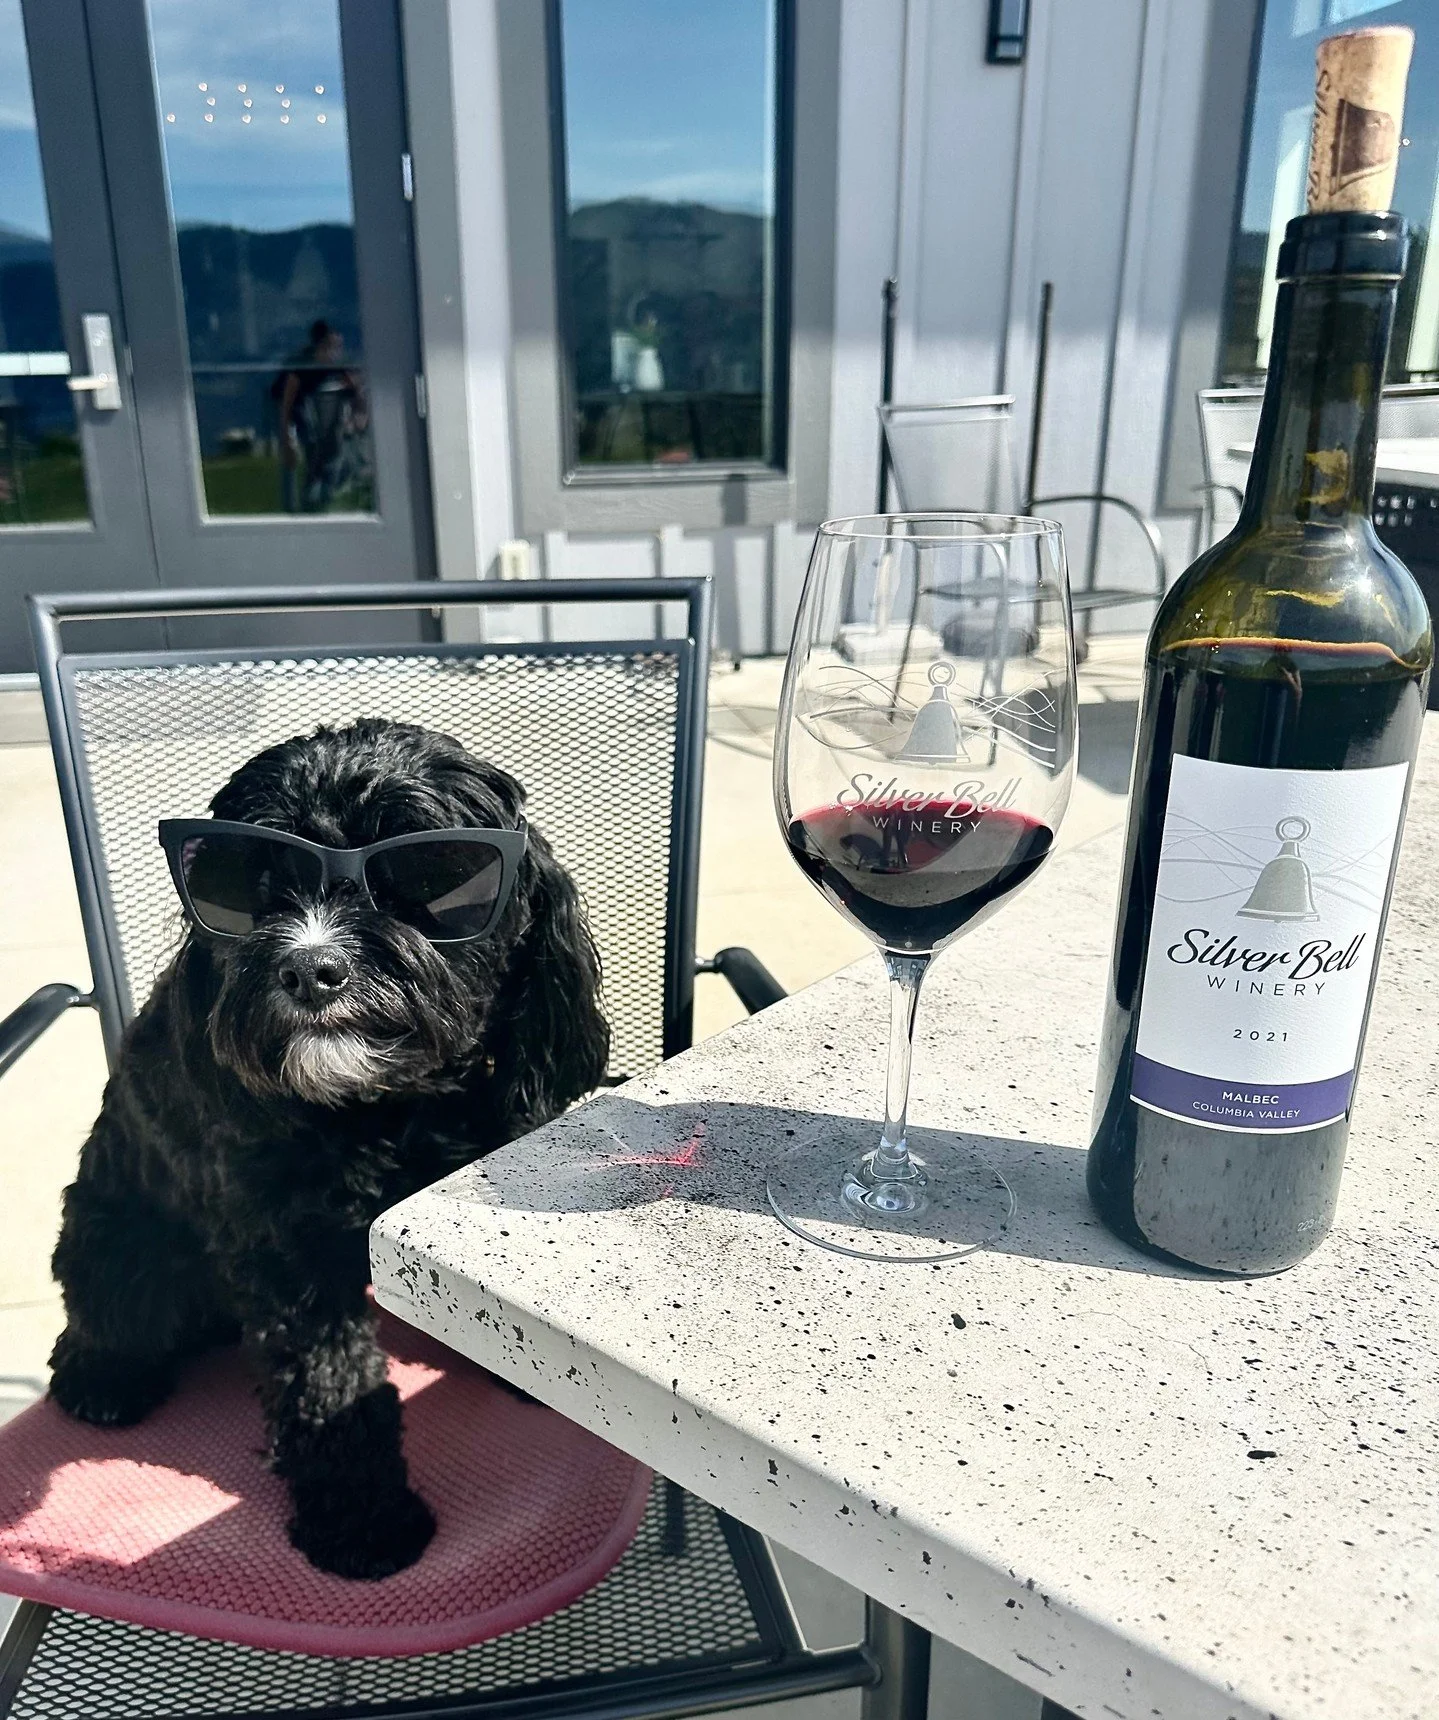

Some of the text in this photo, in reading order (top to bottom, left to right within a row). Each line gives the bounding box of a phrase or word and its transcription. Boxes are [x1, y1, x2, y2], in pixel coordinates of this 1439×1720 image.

[836, 773, 1022, 819] Silver Bell
[872, 816, 982, 834] WINERY
[1167, 928, 1366, 980] Silver Bell
[1207, 974, 1326, 996] WINERY
[1233, 1028, 1289, 1042] 2021
[1222, 1091, 1280, 1105] MALBEC
[1192, 1101, 1301, 1119] COLUMBIA VALLEY
